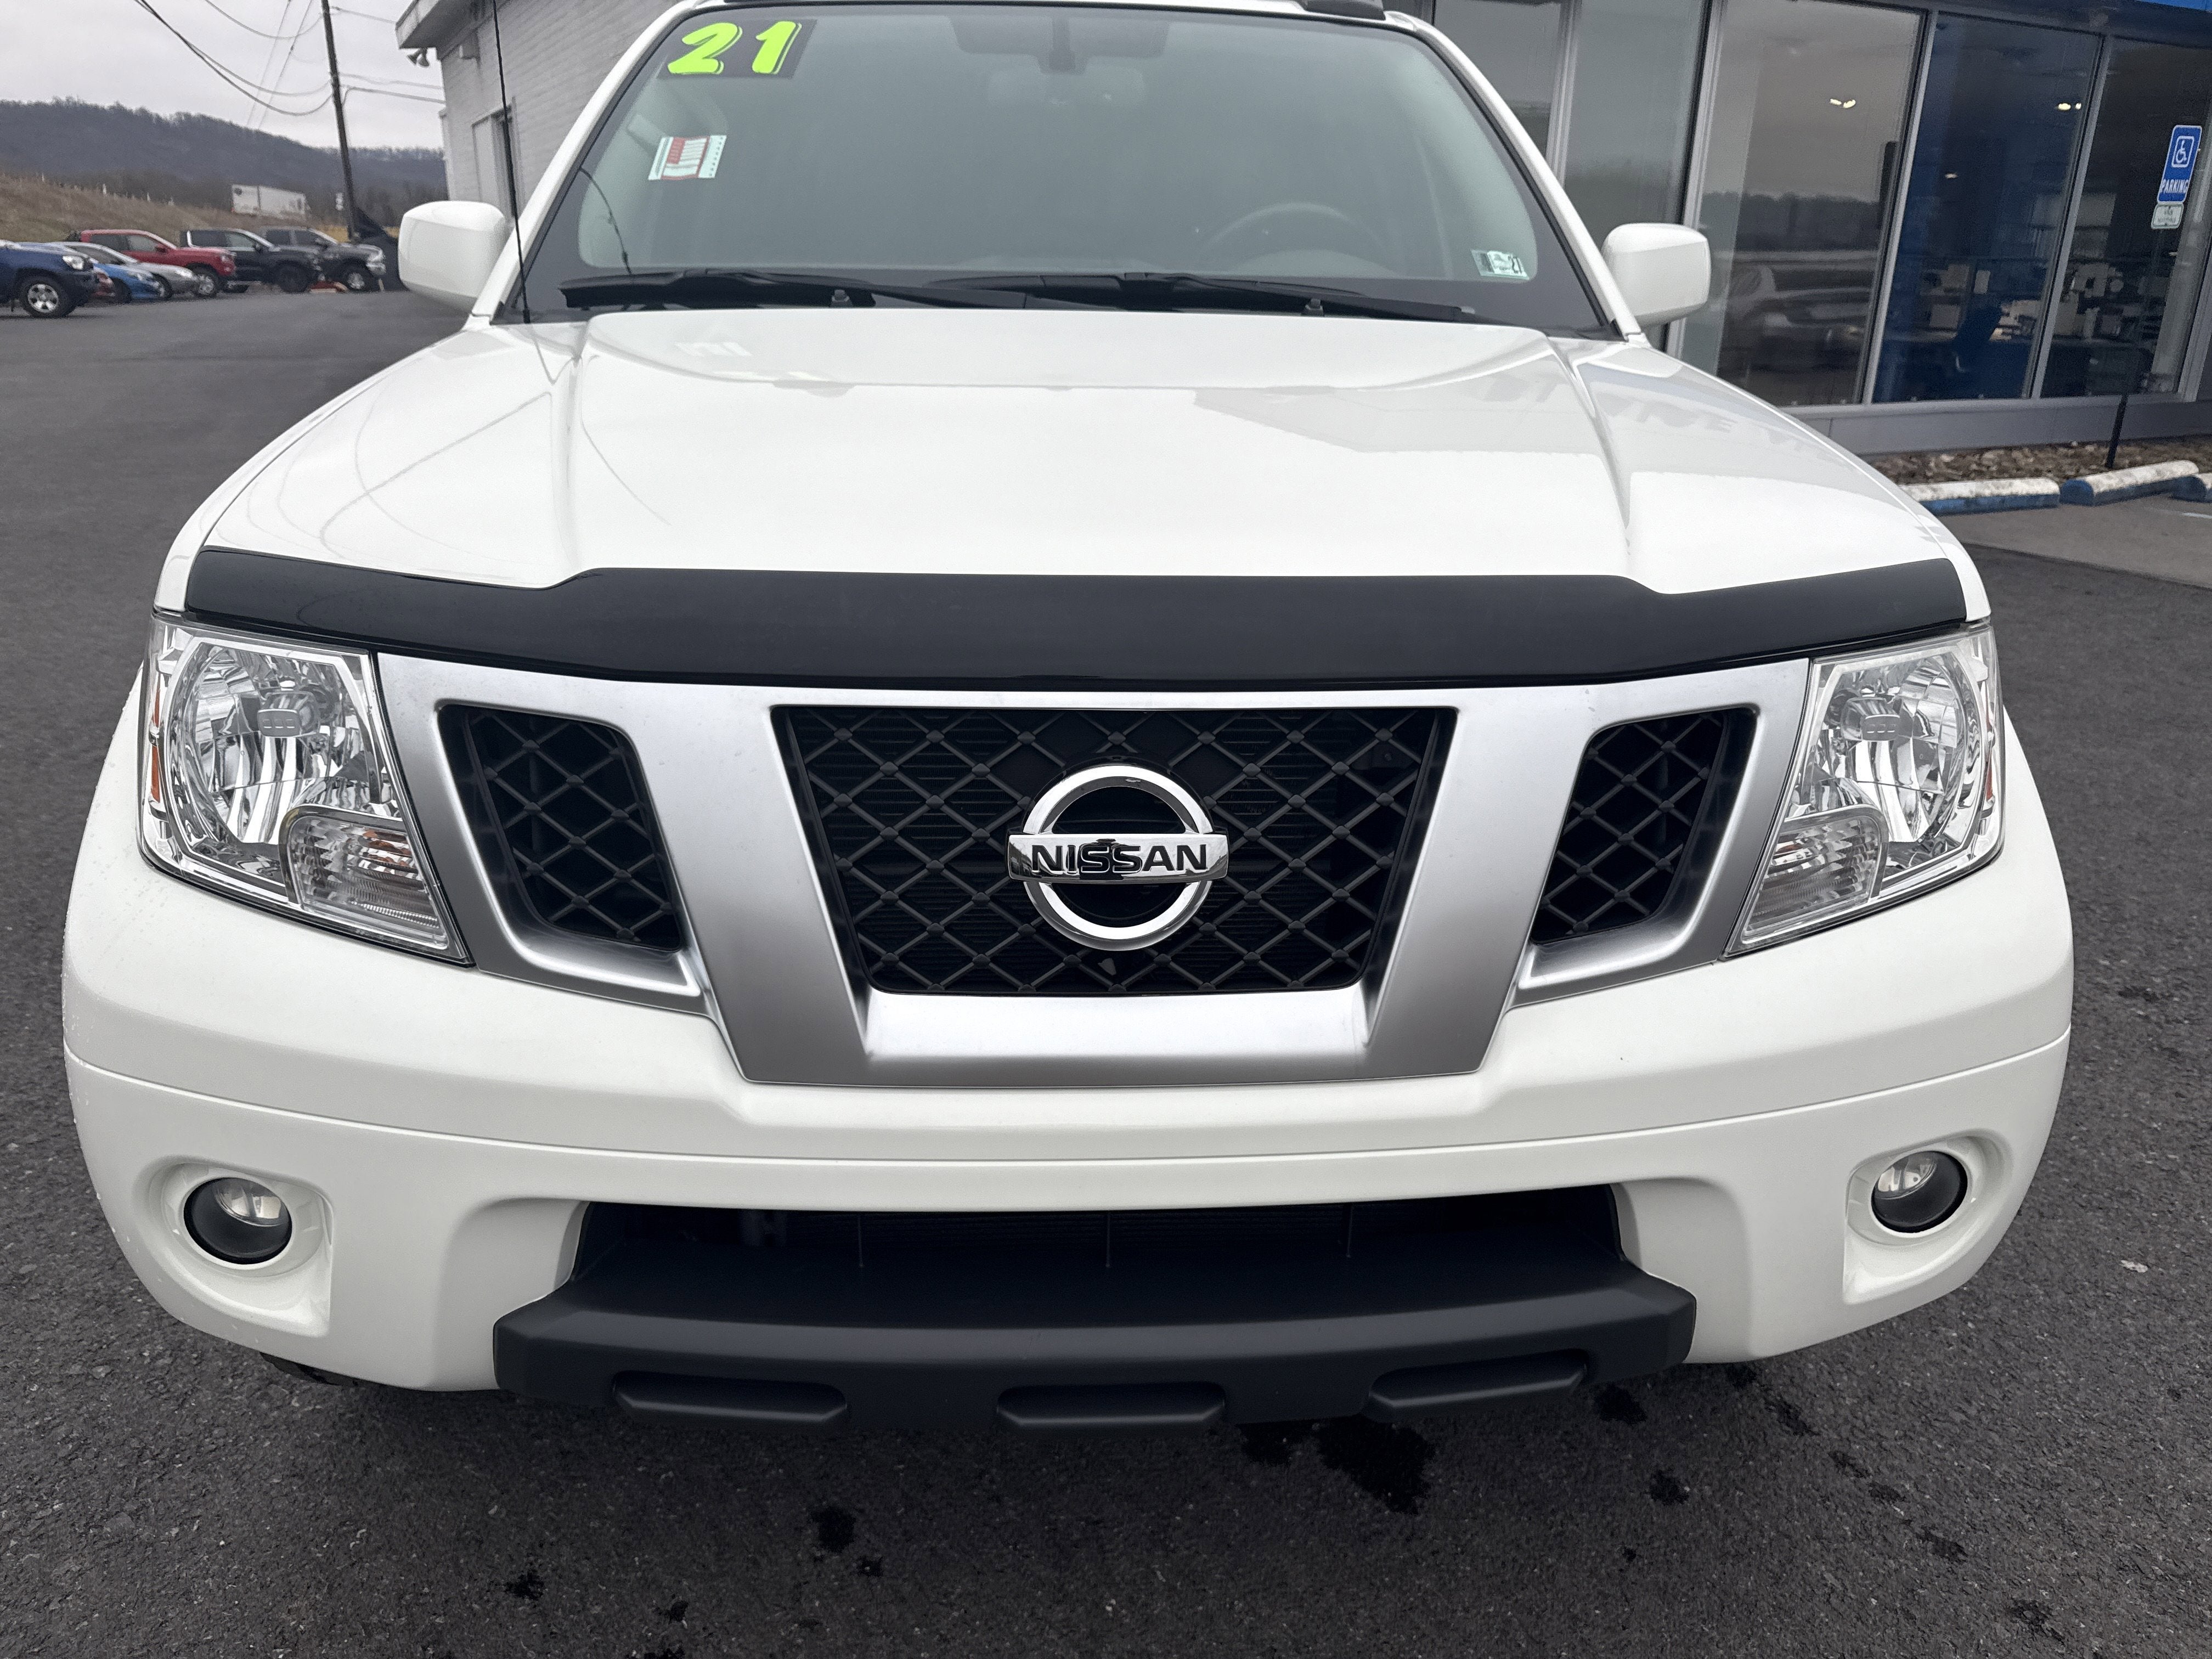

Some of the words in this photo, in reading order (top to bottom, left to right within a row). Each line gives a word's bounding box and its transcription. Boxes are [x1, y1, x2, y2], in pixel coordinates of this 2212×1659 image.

[668, 21, 802, 75] 21
[2162, 179, 2189, 193] PARKING
[1031, 843, 1209, 874] NISSAN
